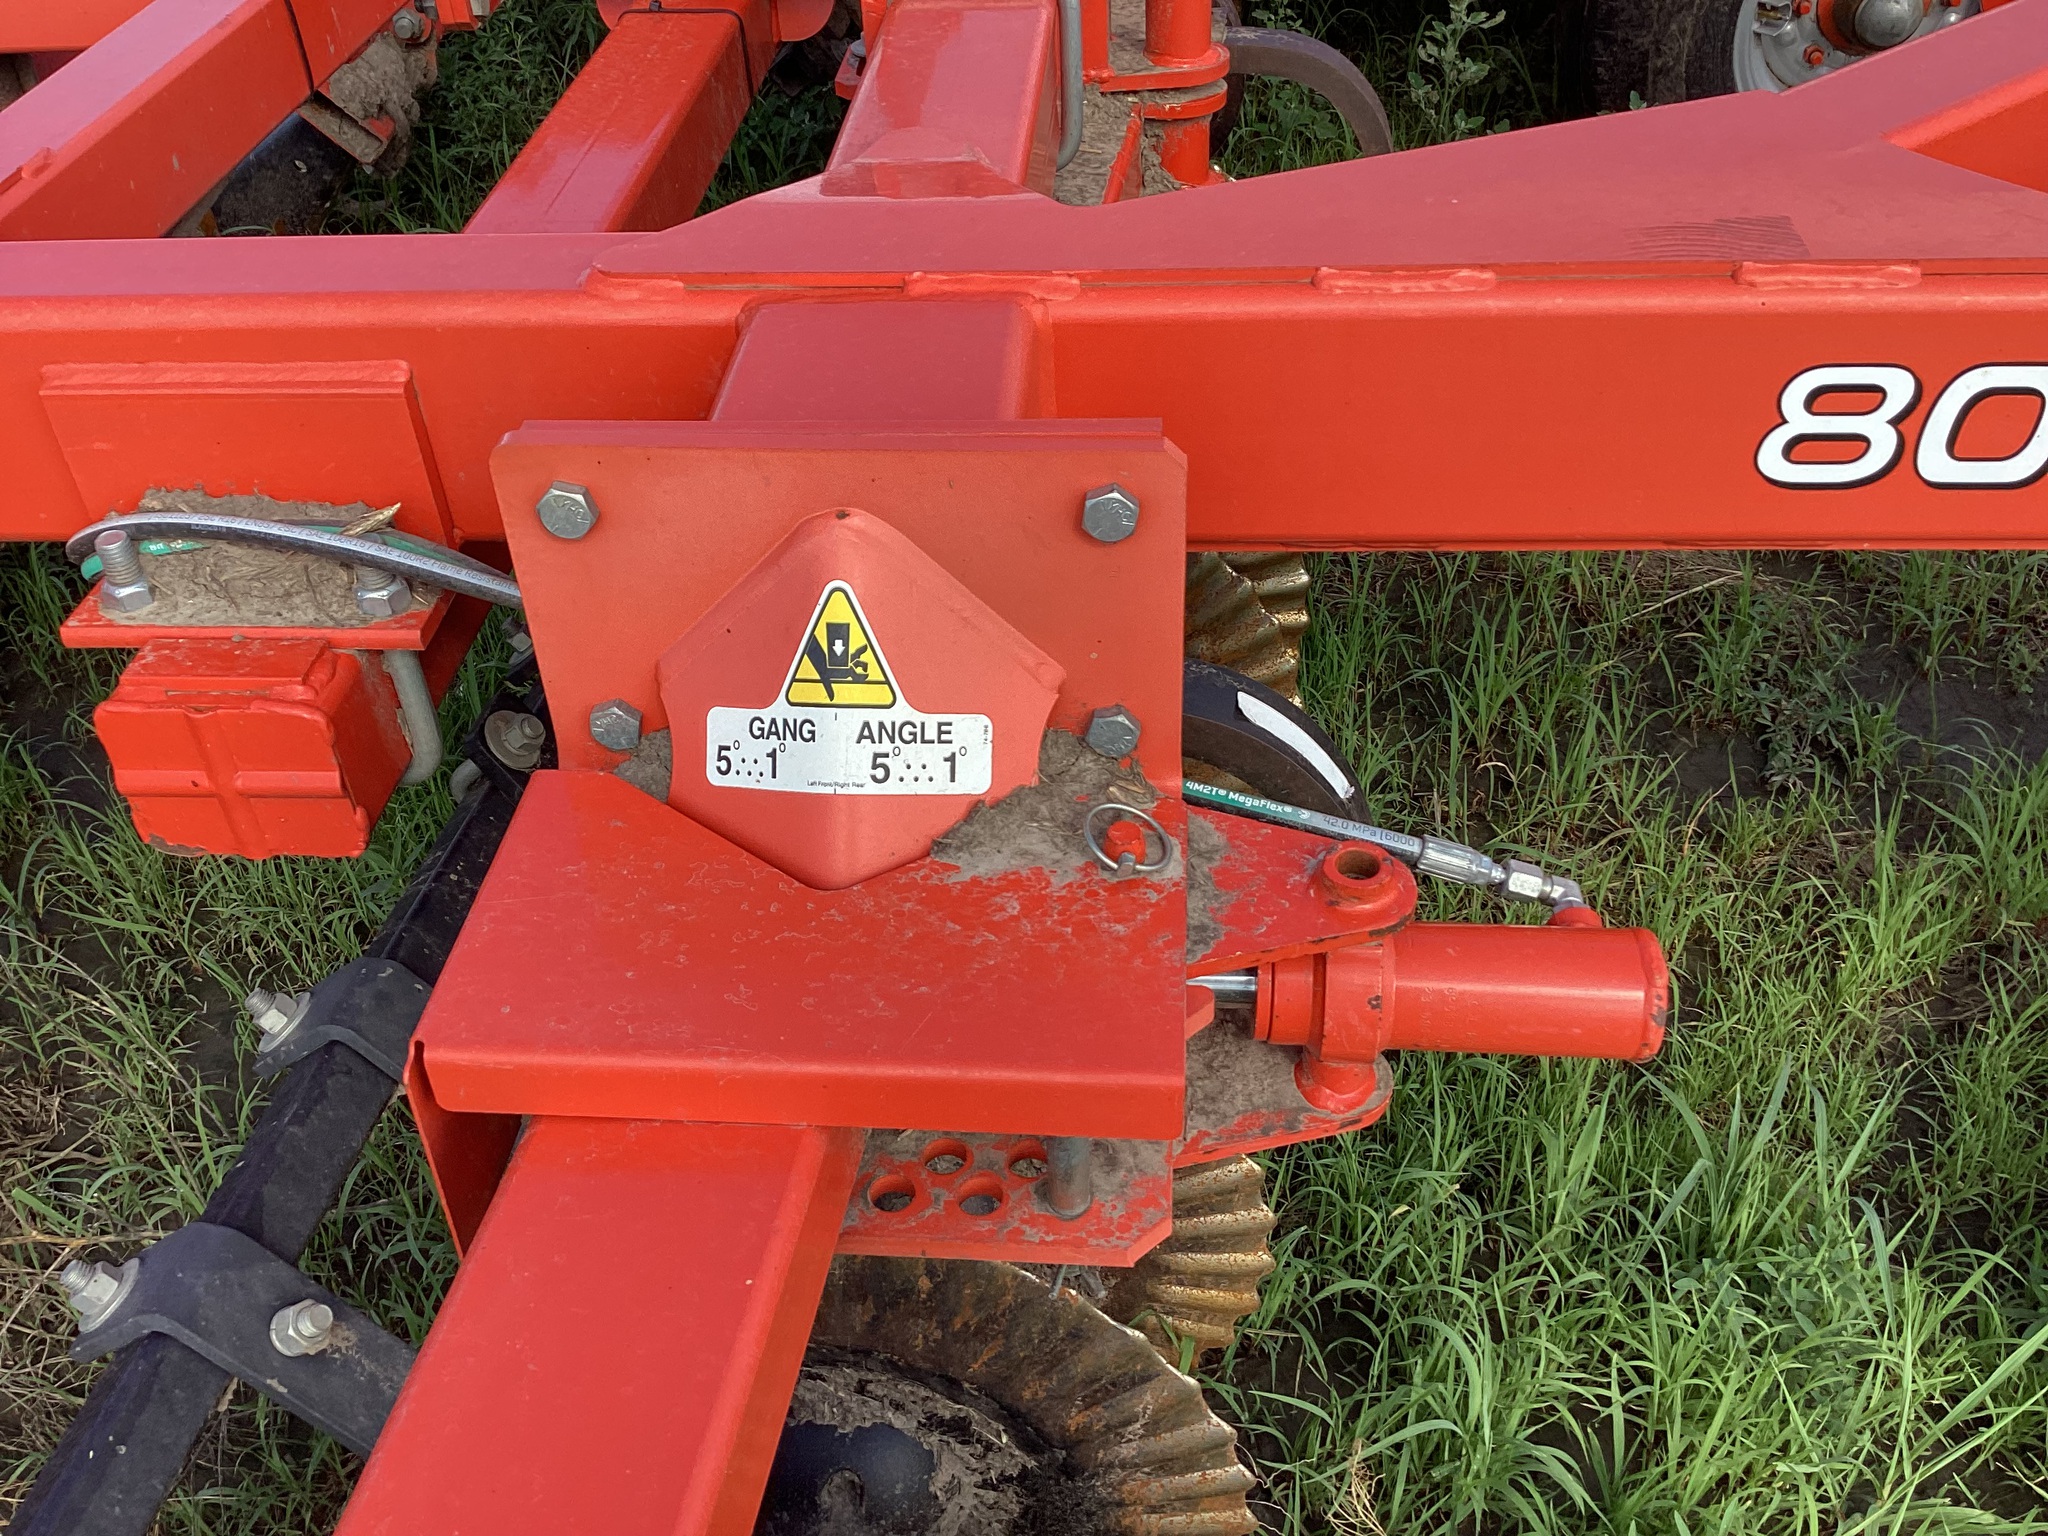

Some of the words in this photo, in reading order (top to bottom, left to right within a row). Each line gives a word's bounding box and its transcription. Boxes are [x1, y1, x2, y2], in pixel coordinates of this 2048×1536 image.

[374, 543, 395, 555] SAE
[431, 560, 462, 575] Flame
[464, 568, 512, 590] Resistant
[749, 716, 816, 742] GANG
[855, 720, 953, 744] ANGLE
[807, 779, 817, 787] Left
[1323, 815, 1349, 831] 42.0
[1351, 824, 1377, 838] MPa
